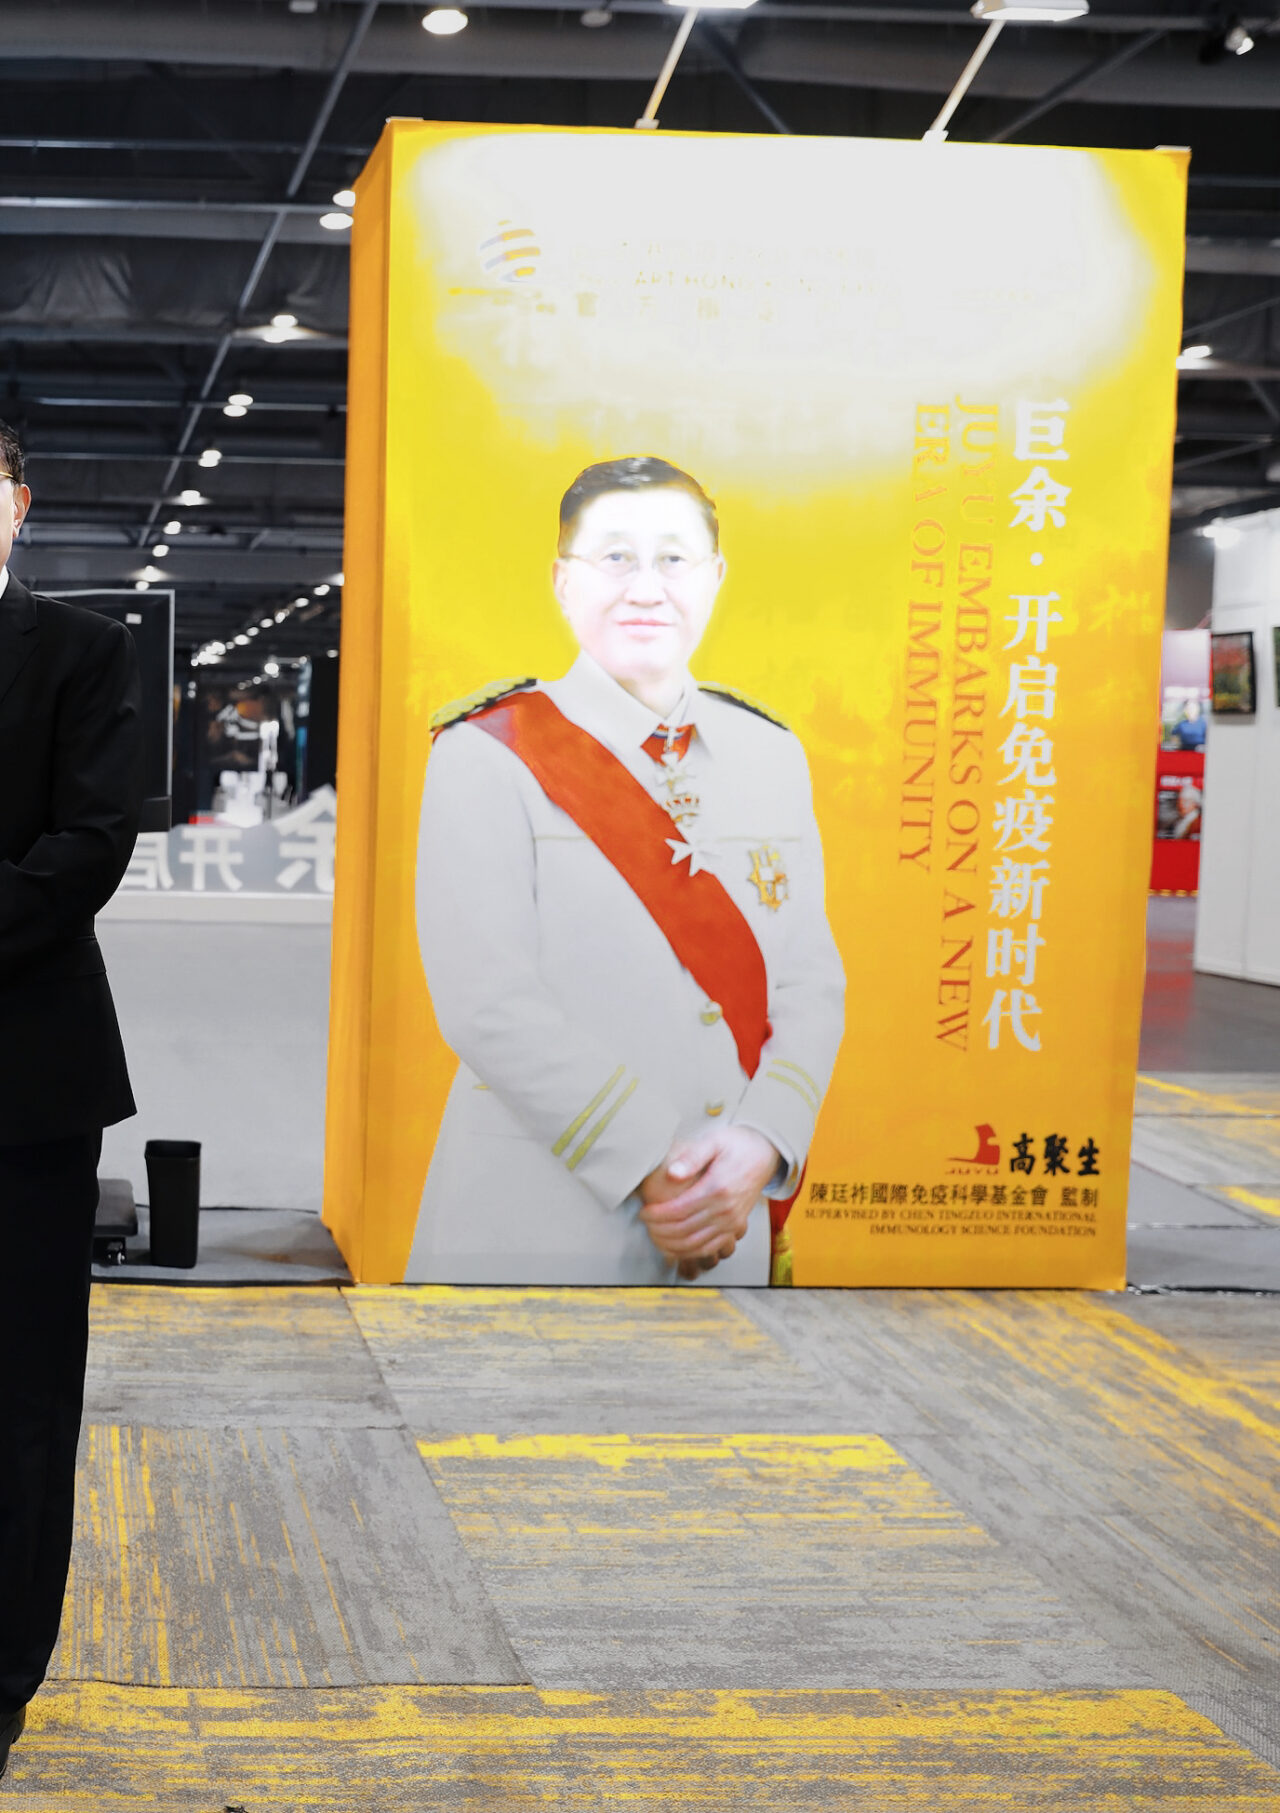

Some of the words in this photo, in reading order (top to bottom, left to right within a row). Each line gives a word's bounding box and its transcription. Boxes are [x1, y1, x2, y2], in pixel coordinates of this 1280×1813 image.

[910, 518, 947, 589] OF
[949, 542, 994, 786] EMBARKS
[898, 600, 944, 874] IMMUNITY
[945, 799, 981, 874] ON
[942, 887, 976, 923] A
[935, 935, 974, 1052] NEW
[881, 1209, 896, 1220] BY
[899, 1209, 935, 1221] CHEN
[996, 1210, 1097, 1223] INTERNATIONAL
[1014, 1224, 1097, 1237] FOUNDATION
